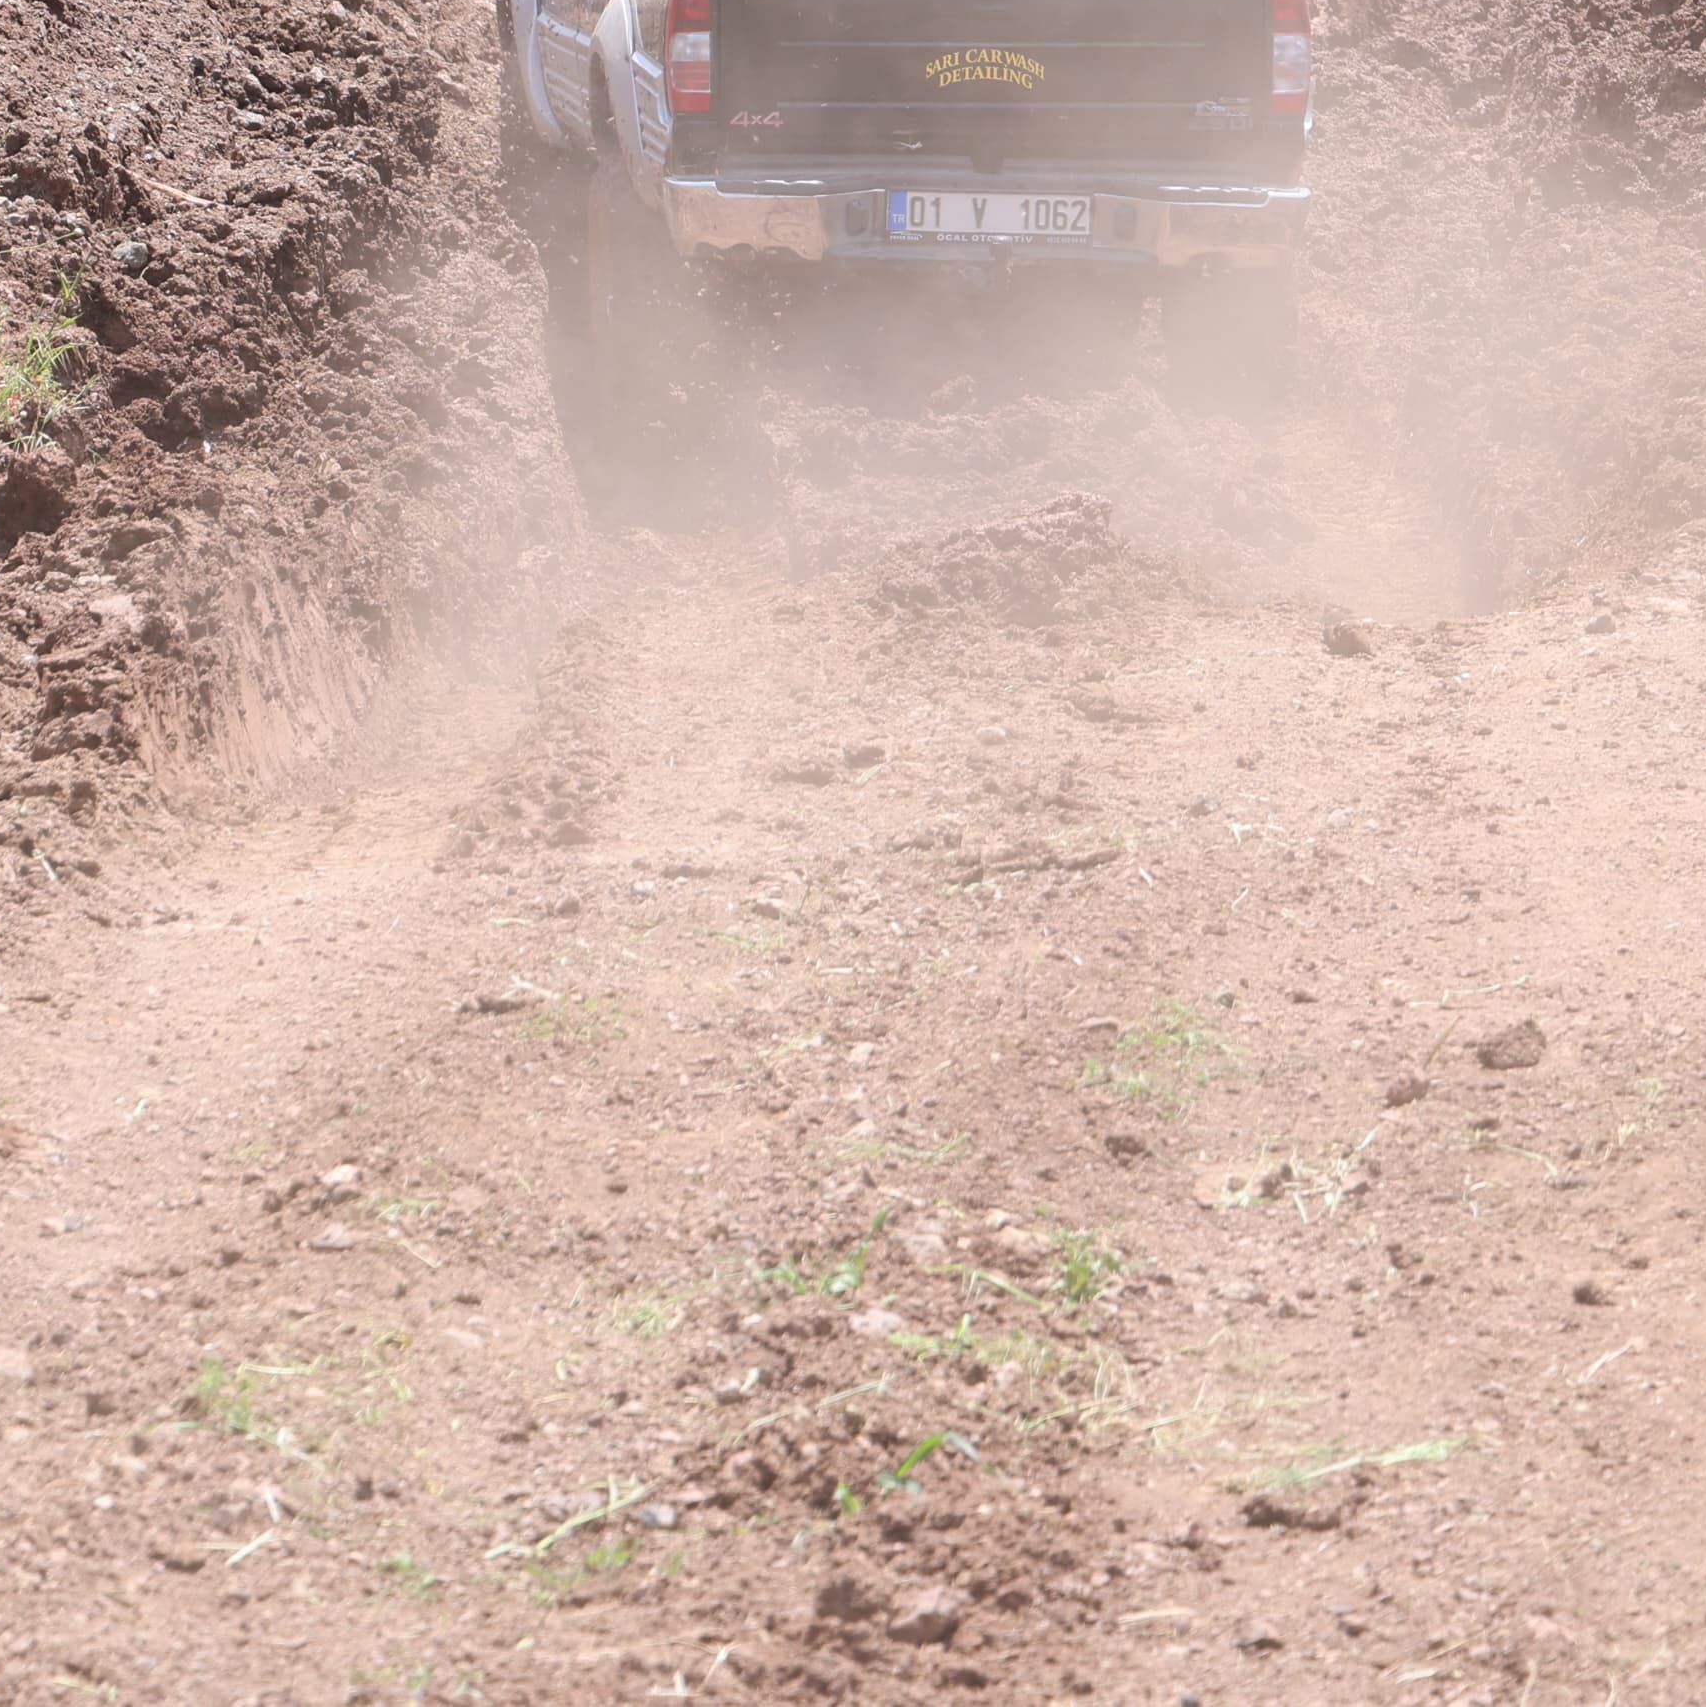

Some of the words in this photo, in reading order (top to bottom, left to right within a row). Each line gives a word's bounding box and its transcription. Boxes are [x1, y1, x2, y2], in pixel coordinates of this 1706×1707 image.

[926, 51, 961, 78] SARI
[964, 48, 1003, 64] CAR
[1003, 50, 1045, 80] WASH
[729, 111, 784, 129] 4x4
[892, 213, 906, 224] TR
[909, 195, 942, 228] 01
[972, 197, 987, 229] V
[1020, 199, 1088, 231] 1062
